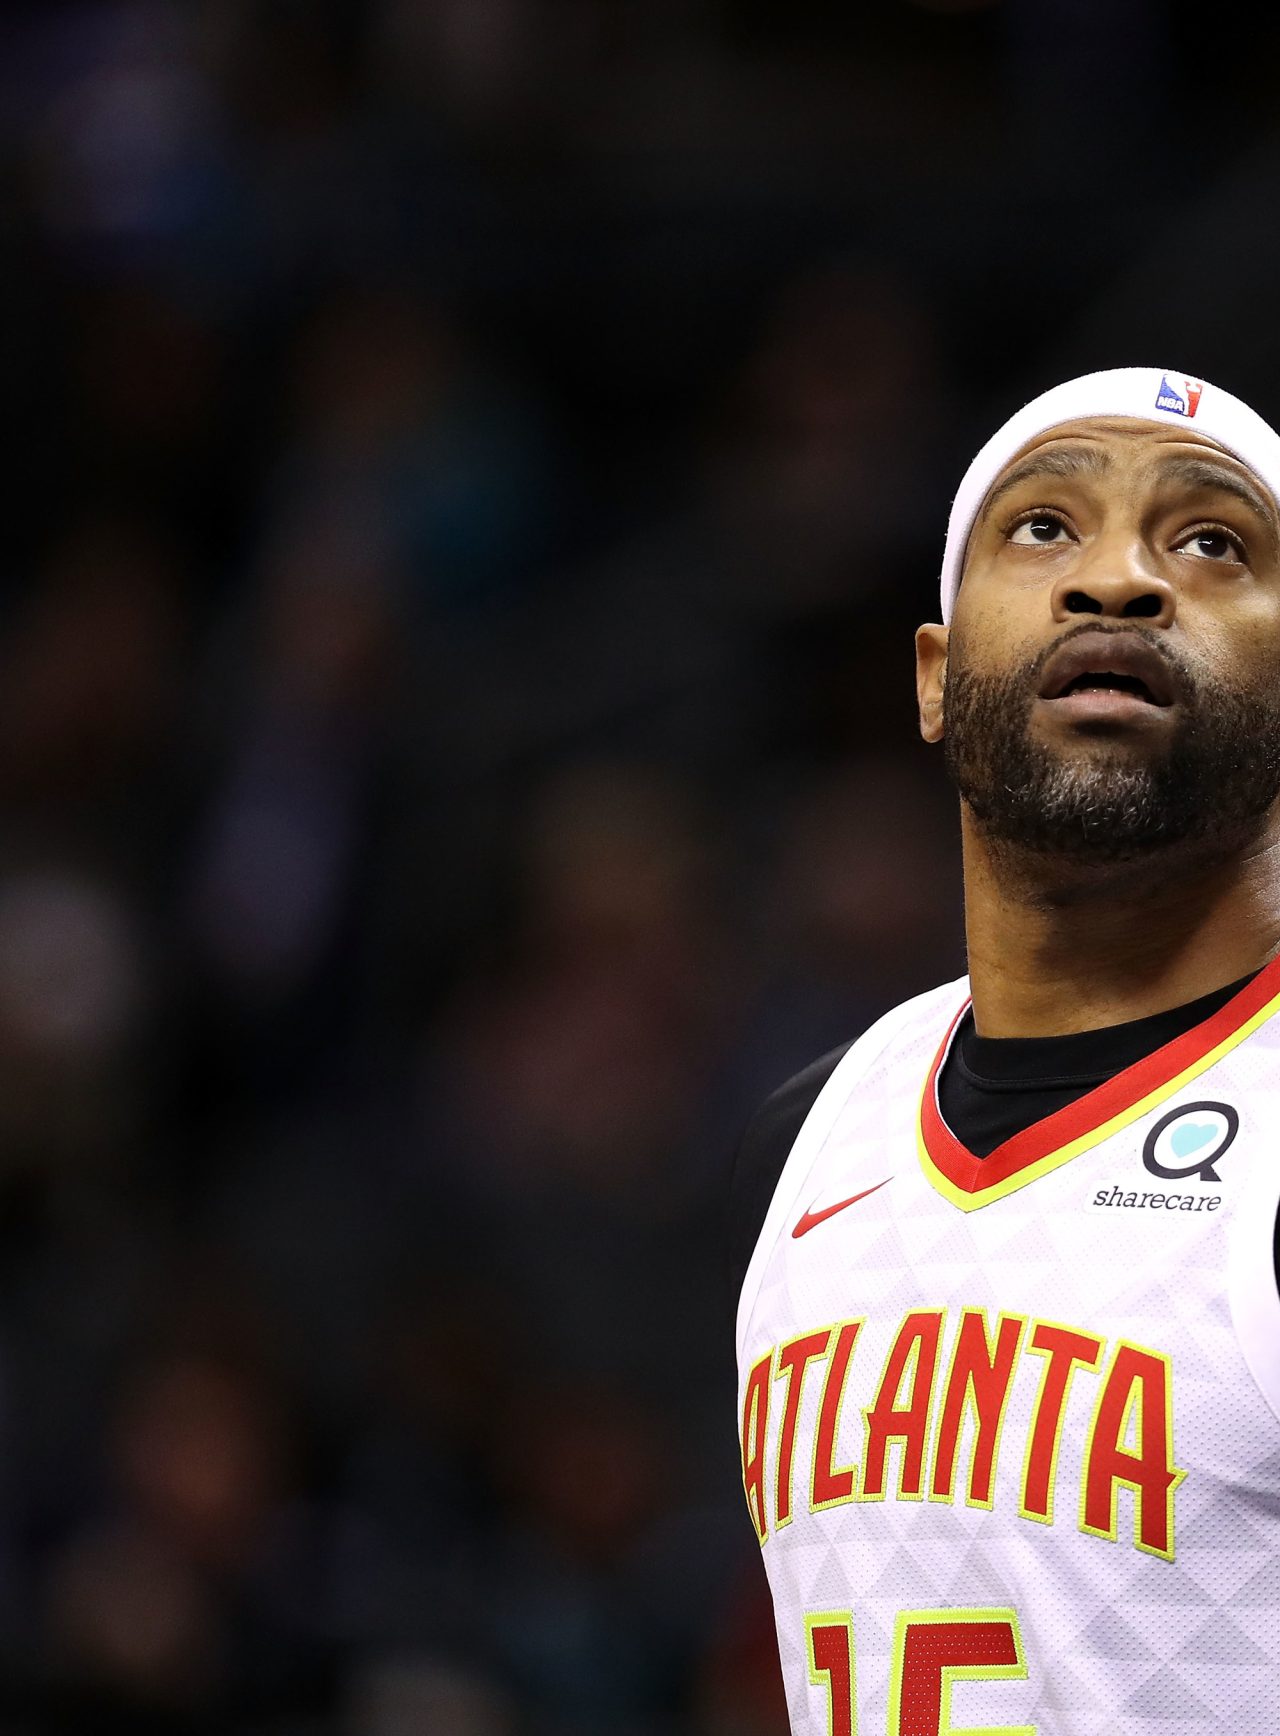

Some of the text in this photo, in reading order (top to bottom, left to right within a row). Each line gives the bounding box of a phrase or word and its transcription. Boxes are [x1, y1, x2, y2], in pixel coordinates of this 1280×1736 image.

[1158, 396, 1184, 411] NBA
[1093, 1186, 1222, 1211] sharecare
[742, 1306, 1189, 1562] ATLANTA
